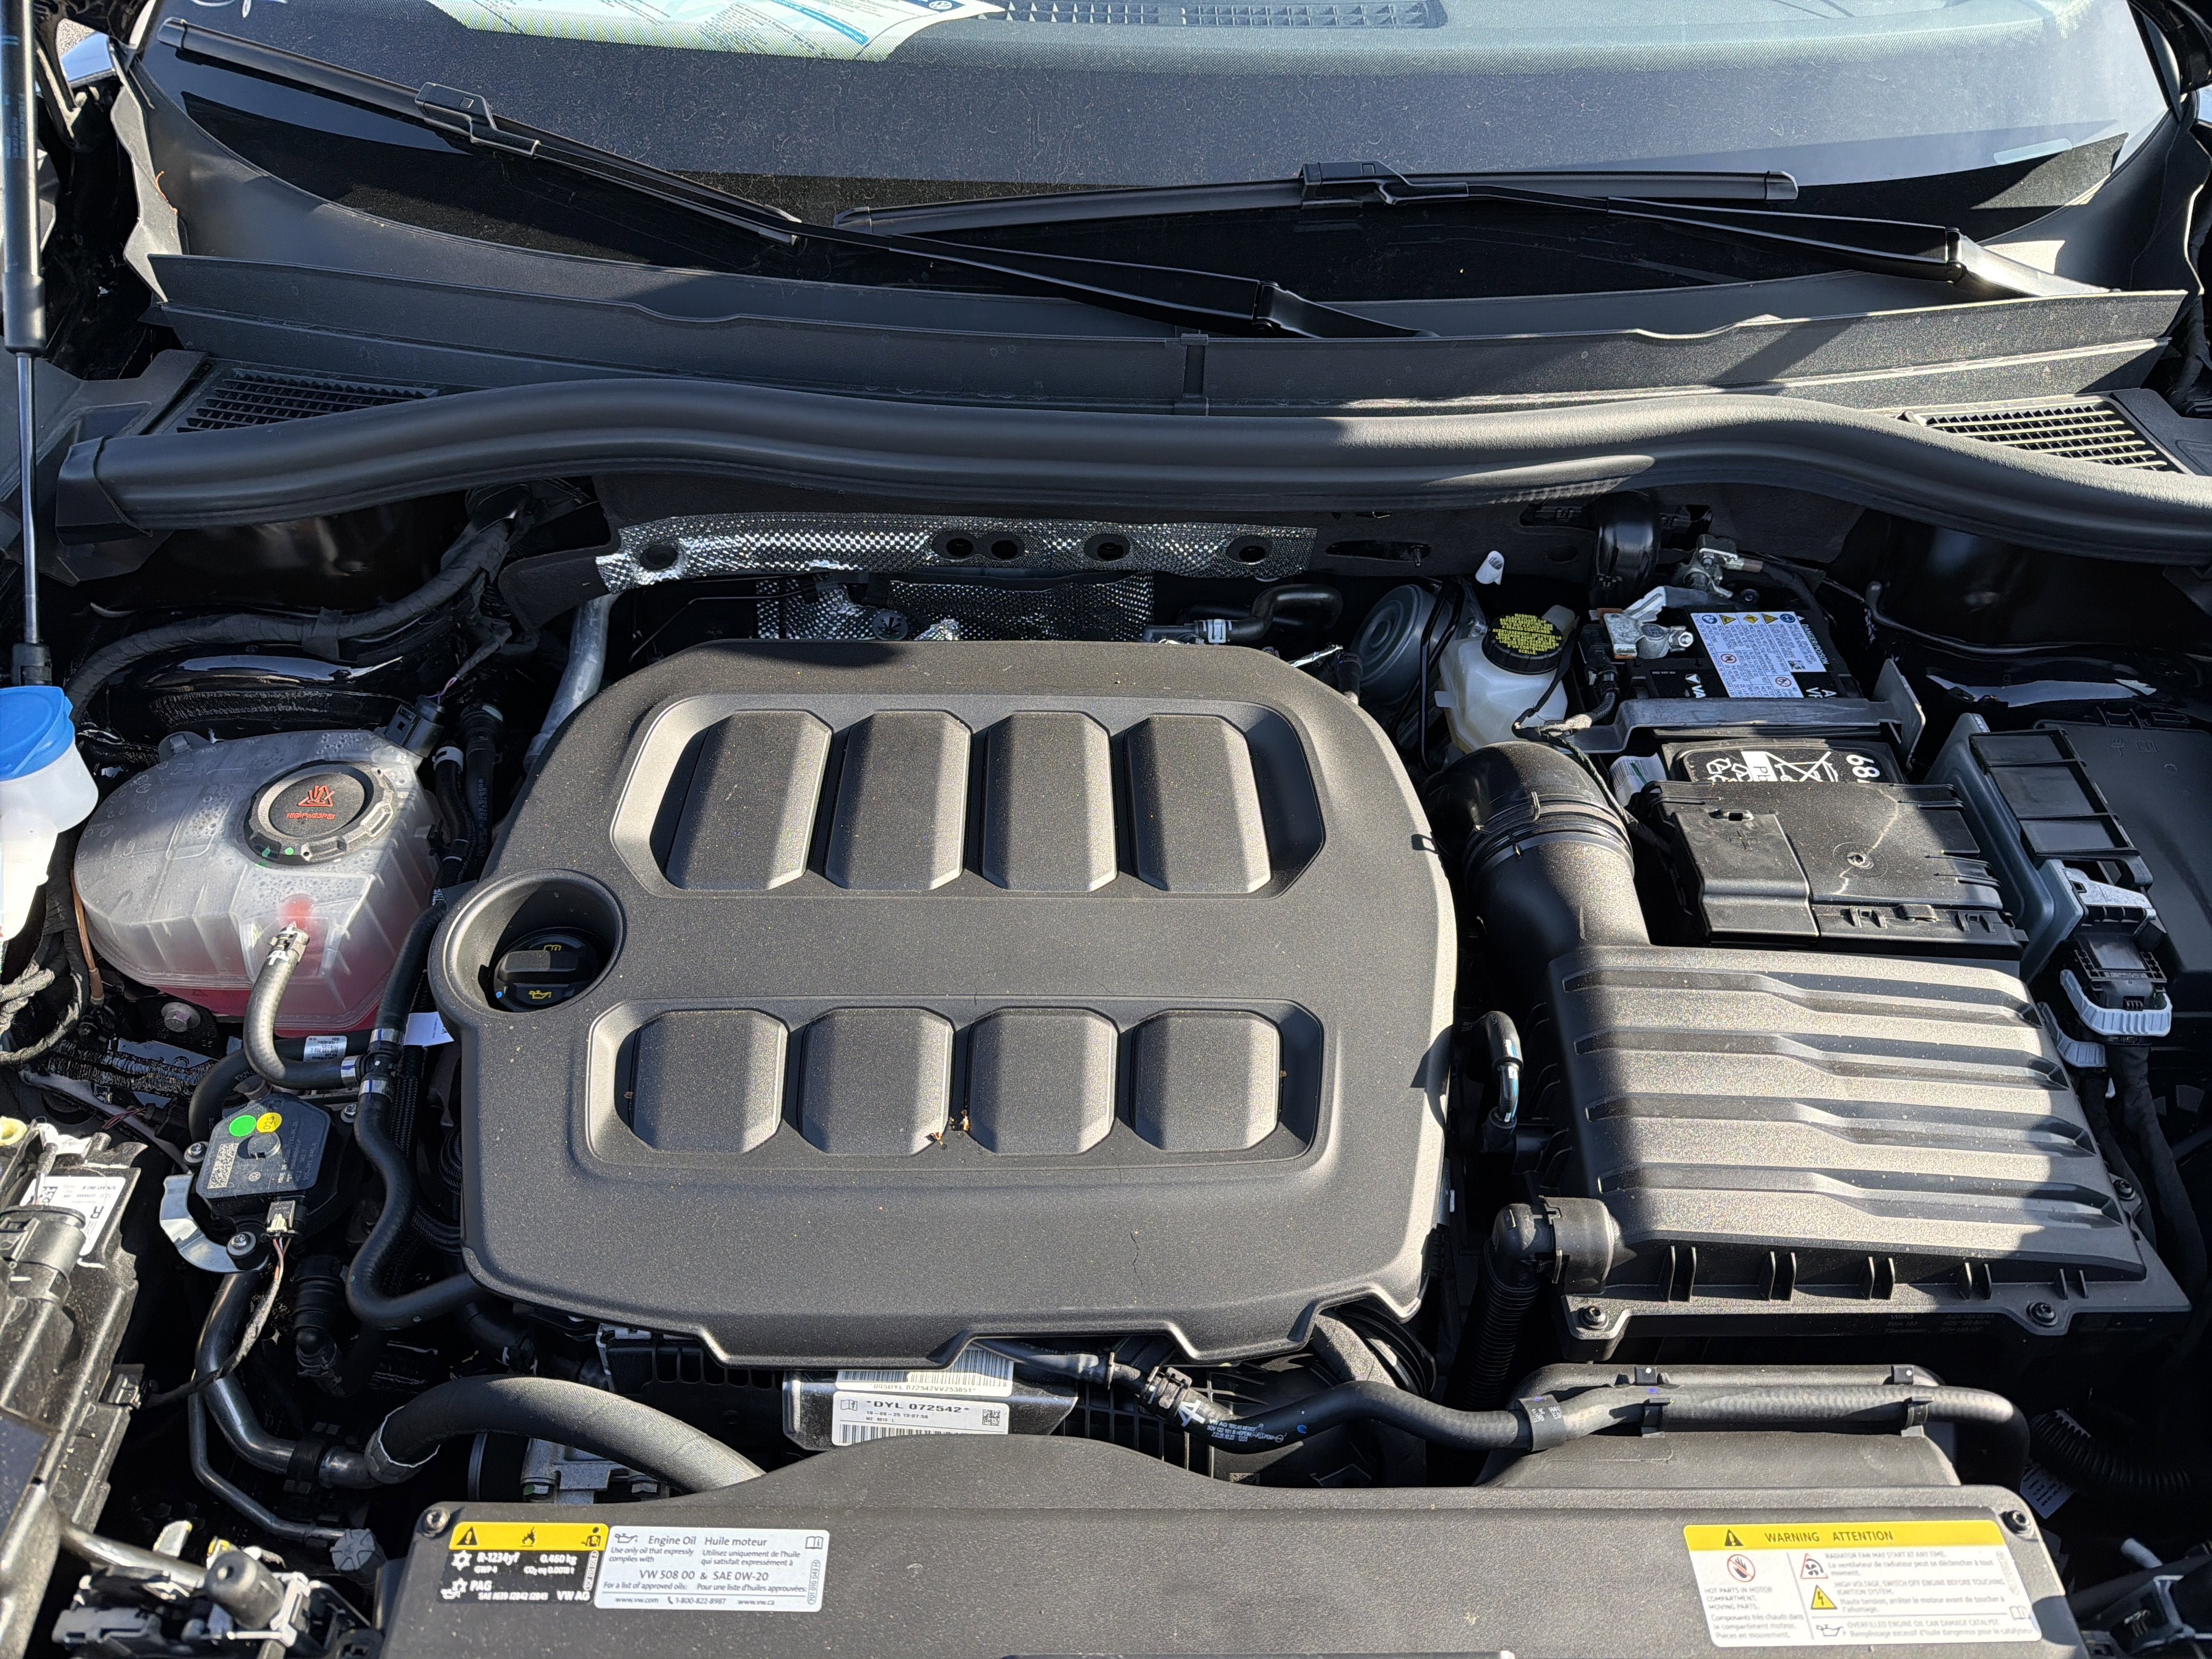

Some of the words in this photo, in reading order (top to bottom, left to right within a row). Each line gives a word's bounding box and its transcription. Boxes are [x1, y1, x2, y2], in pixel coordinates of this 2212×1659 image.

[648, 1536, 681, 1547] Engine
[682, 1536, 697, 1545] Oil
[704, 1537, 730, 1546] Huile
[731, 1538, 767, 1547] moteur
[1764, 1532, 1820, 1543] WARNING
[1833, 1531, 1894, 1542] ATTENTION
[663, 1548, 695, 1556] expressly
[729, 1550, 769, 1559] uniquement
[476, 1551, 521, 1565] R-1234yf
[639, 1570, 658, 1578] VW
[659, 1570, 679, 1579] 508
[681, 1570, 696, 1580] 00
[699, 1572, 708, 1580] &
[713, 1571, 732, 1581] SAE
[735, 1571, 769, 1581] 0W-20
[469, 1580, 493, 1591] PAG
[641, 1582, 673, 1591] approved
[741, 1583, 767, 1592] d'huiles
[556, 1590, 574, 1601] VW
[575, 1591, 590, 1601] AG
